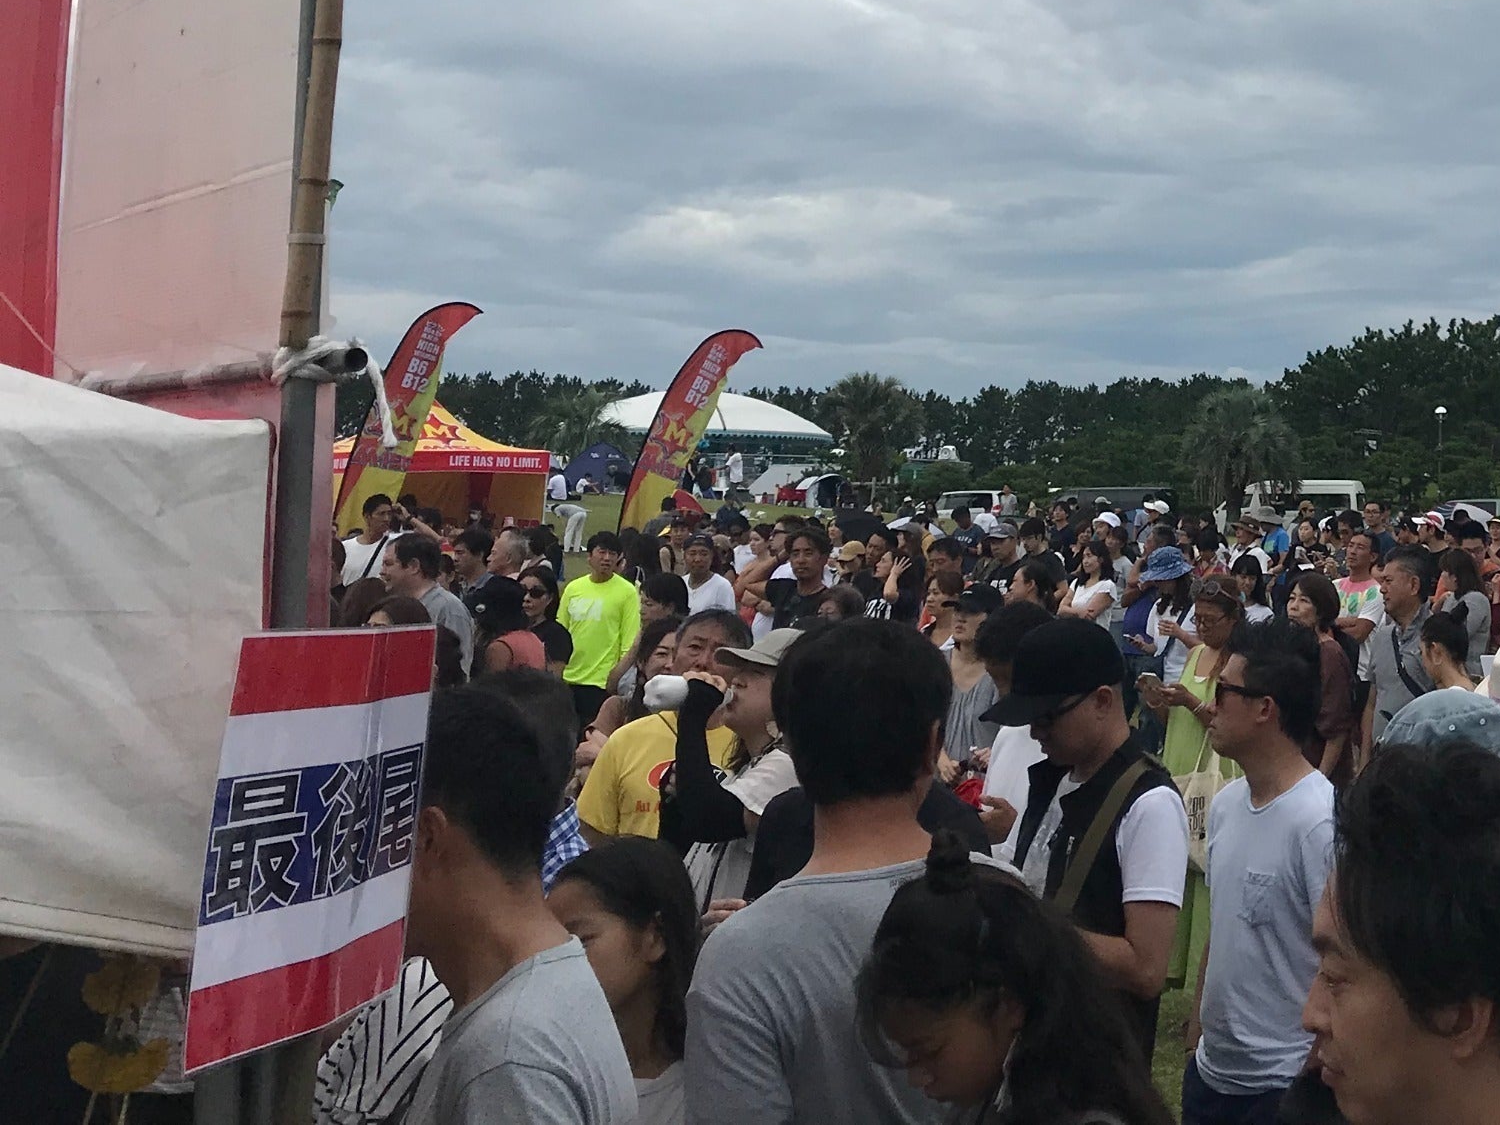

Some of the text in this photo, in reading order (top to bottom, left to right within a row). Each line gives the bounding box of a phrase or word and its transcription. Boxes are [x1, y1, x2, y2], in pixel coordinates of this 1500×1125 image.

[407, 357, 429, 376] B6
[401, 373, 429, 393] B12
[691, 375, 711, 394] B6
[684, 389, 709, 410] B12
[449, 455, 542, 469] LIFE HAS NO LIMIT.
[206, 746, 422, 918] 最後尾
